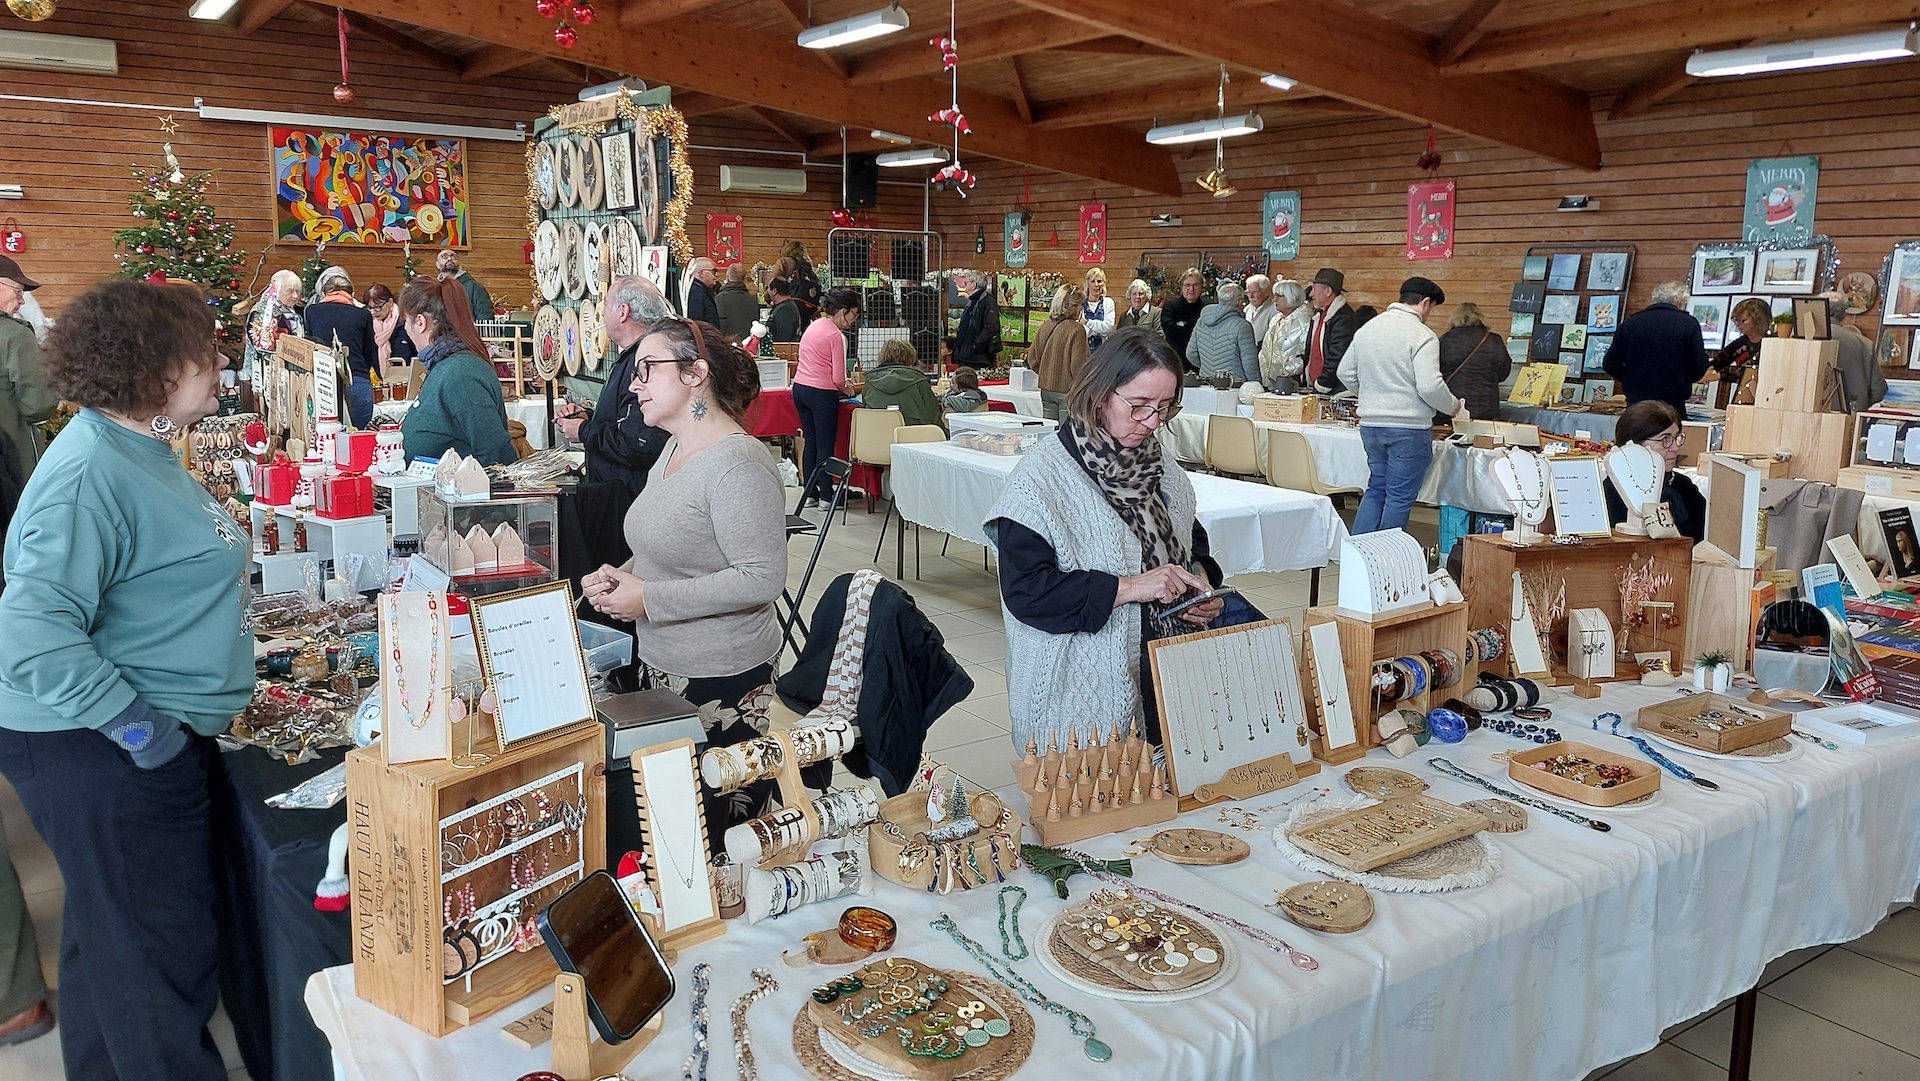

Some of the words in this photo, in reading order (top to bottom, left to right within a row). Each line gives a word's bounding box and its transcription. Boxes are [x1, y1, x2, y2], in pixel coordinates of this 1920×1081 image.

[1760, 168, 1806, 184] MERRY
[1430, 192, 1448, 202] MERRY
[1270, 198, 1296, 211] MERRY
[488, 625, 508, 634] Boucles
[508, 620, 533, 629] d'oreilles
[493, 647, 515, 657] Bracelet
[498, 672, 515, 681] Collier
[503, 696, 520, 705] Bague
[1248, 763, 1274, 782] bijoux
[1257, 780, 1267, 793] de
[1266, 771, 1295, 789] Marie
[355, 801, 371, 859] HAUT
[374, 851, 386, 927] CHÂTEAU
[357, 869, 376, 963] LALANDE
[424, 904, 430, 917] DE
